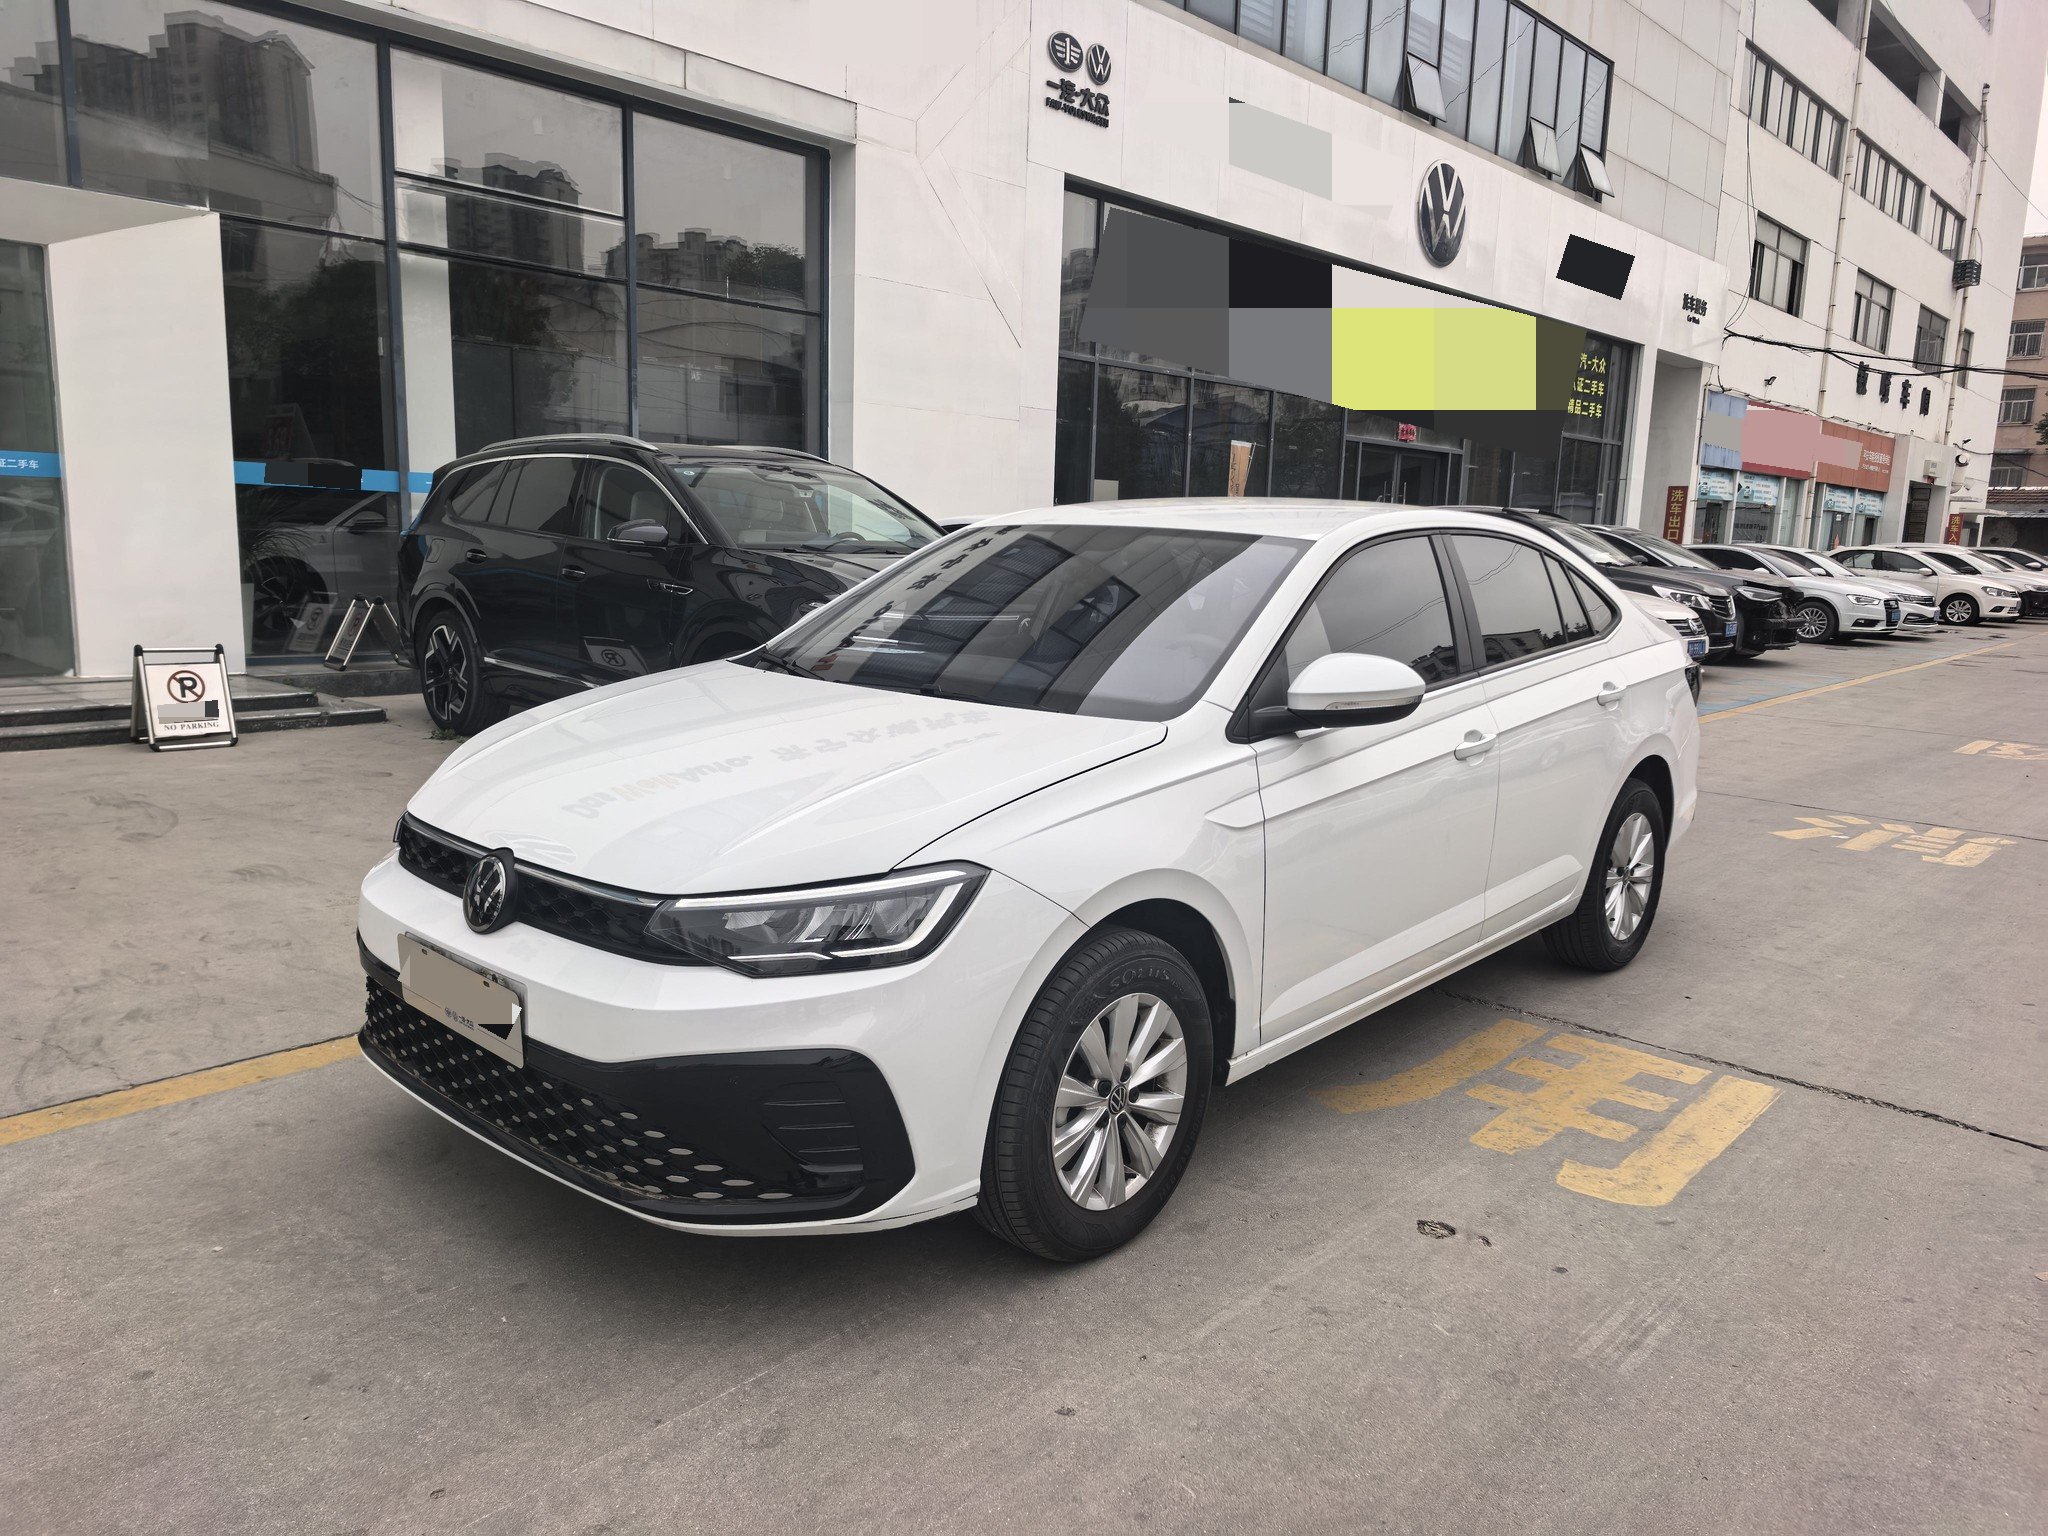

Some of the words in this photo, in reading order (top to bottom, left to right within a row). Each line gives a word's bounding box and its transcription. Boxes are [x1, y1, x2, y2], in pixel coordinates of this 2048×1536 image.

[1573, 376, 1605, 396] 证二手车
[1667, 489, 1685, 541] 洗车出口
[163, 723, 178, 732] NO
[180, 721, 220, 731] PARKING
